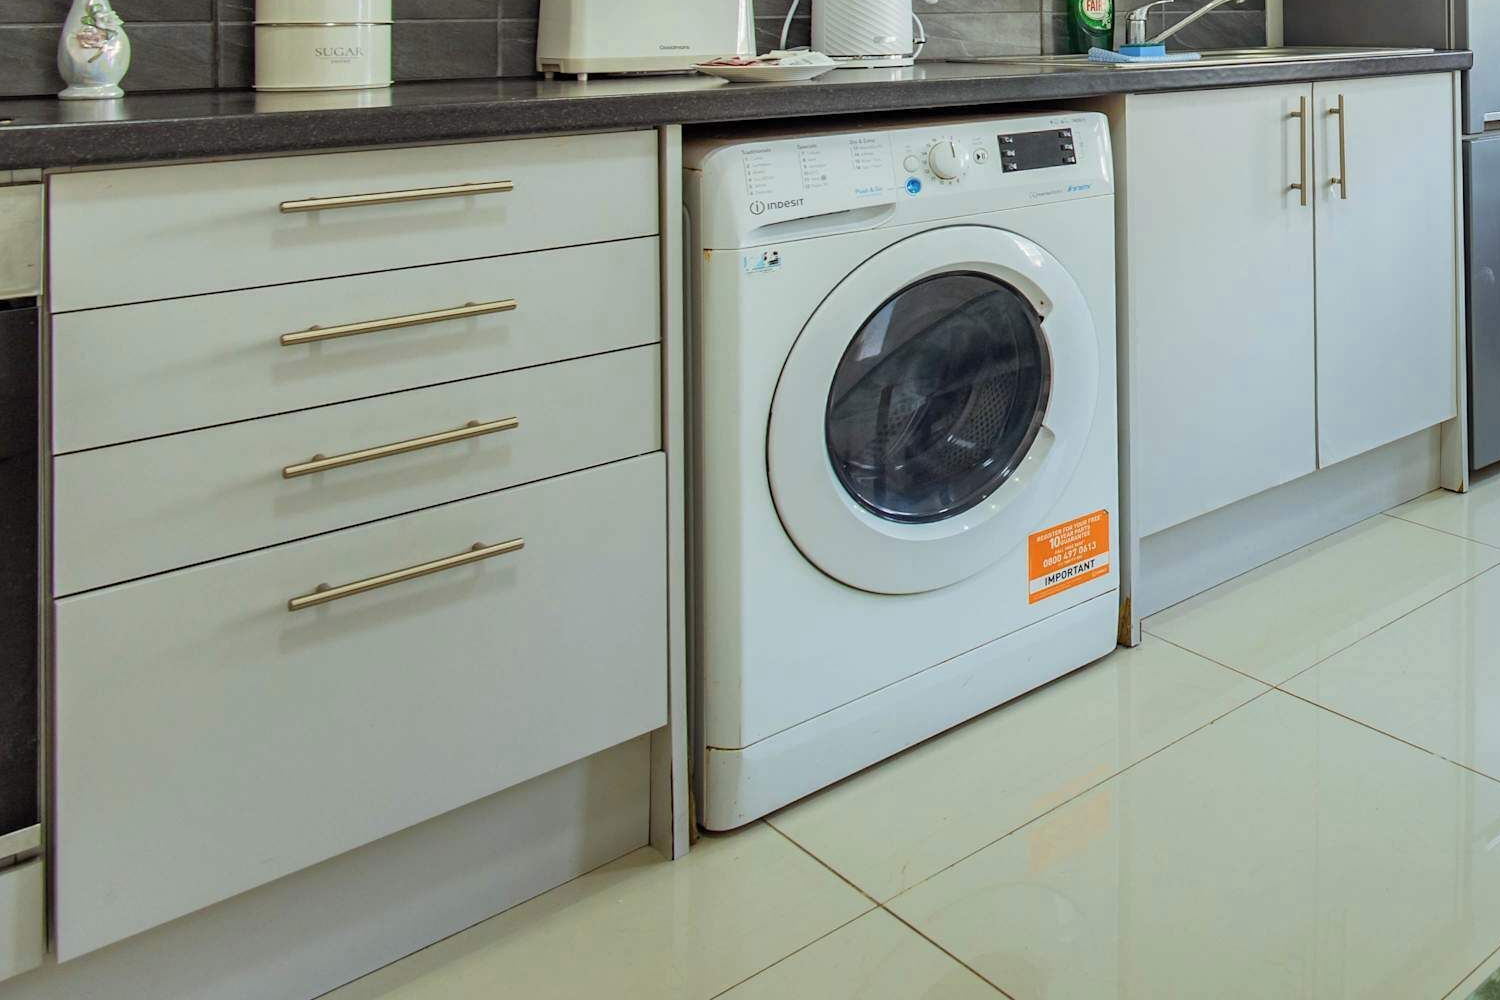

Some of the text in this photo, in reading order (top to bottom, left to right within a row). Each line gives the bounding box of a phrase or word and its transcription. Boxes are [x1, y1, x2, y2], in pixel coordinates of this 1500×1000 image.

[314, 47, 364, 57] SUGAR
[1049, 535, 1061, 549] 10
[1044, 559, 1096, 586] IMPORTANT
